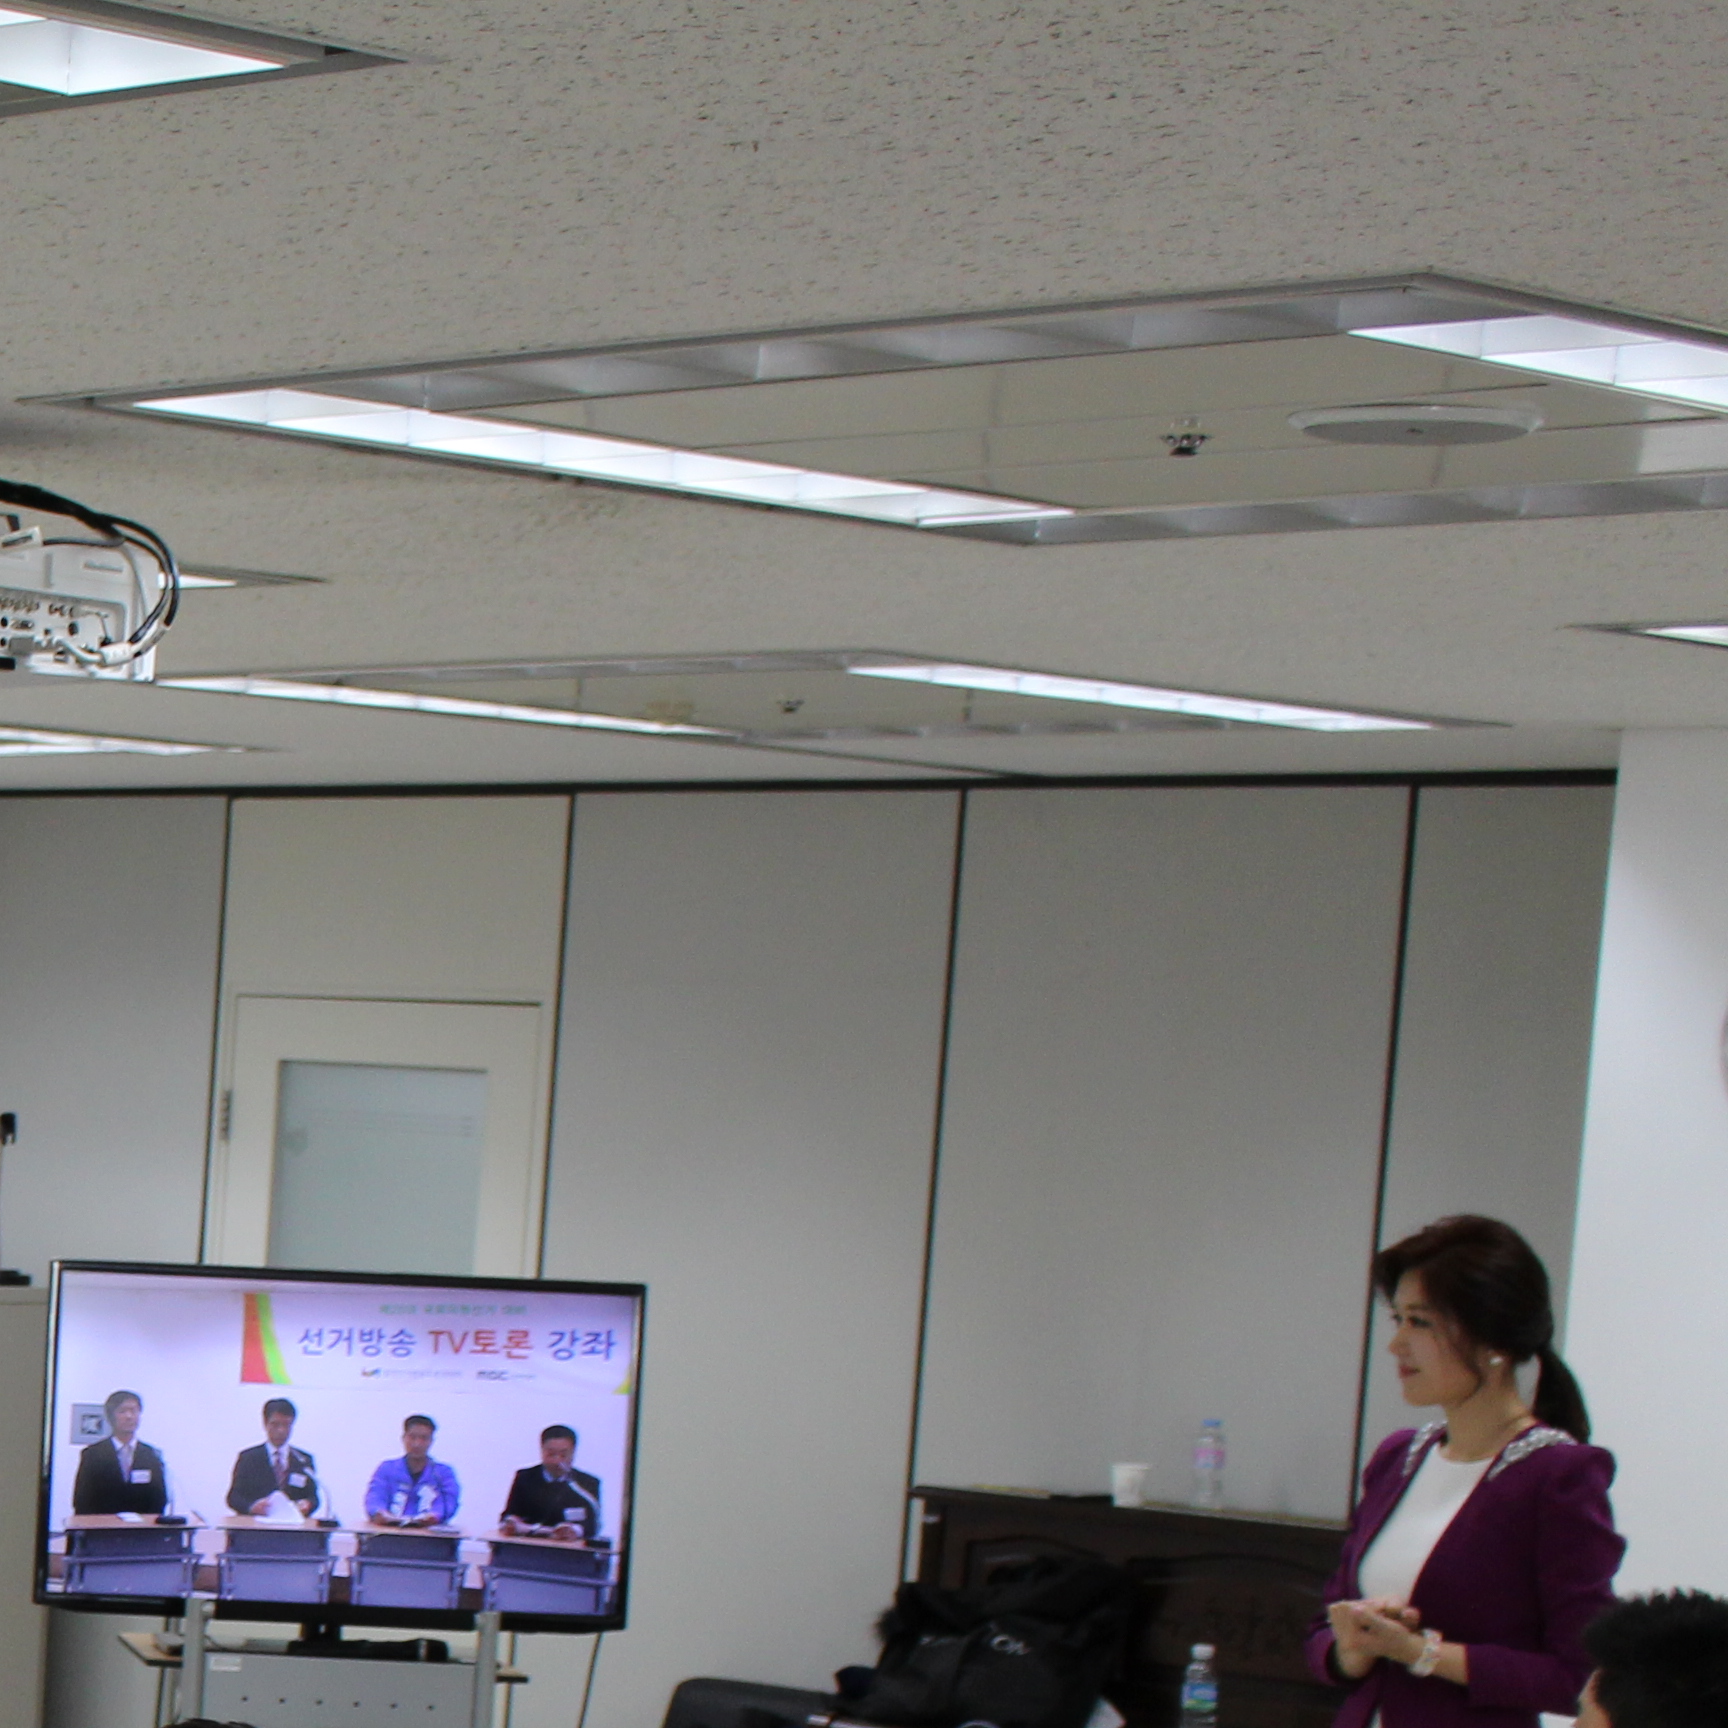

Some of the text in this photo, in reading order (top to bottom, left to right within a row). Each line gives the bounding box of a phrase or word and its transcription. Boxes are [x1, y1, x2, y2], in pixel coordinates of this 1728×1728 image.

[299, 1326, 618, 1361] 선거방송 TV토론 강좌
